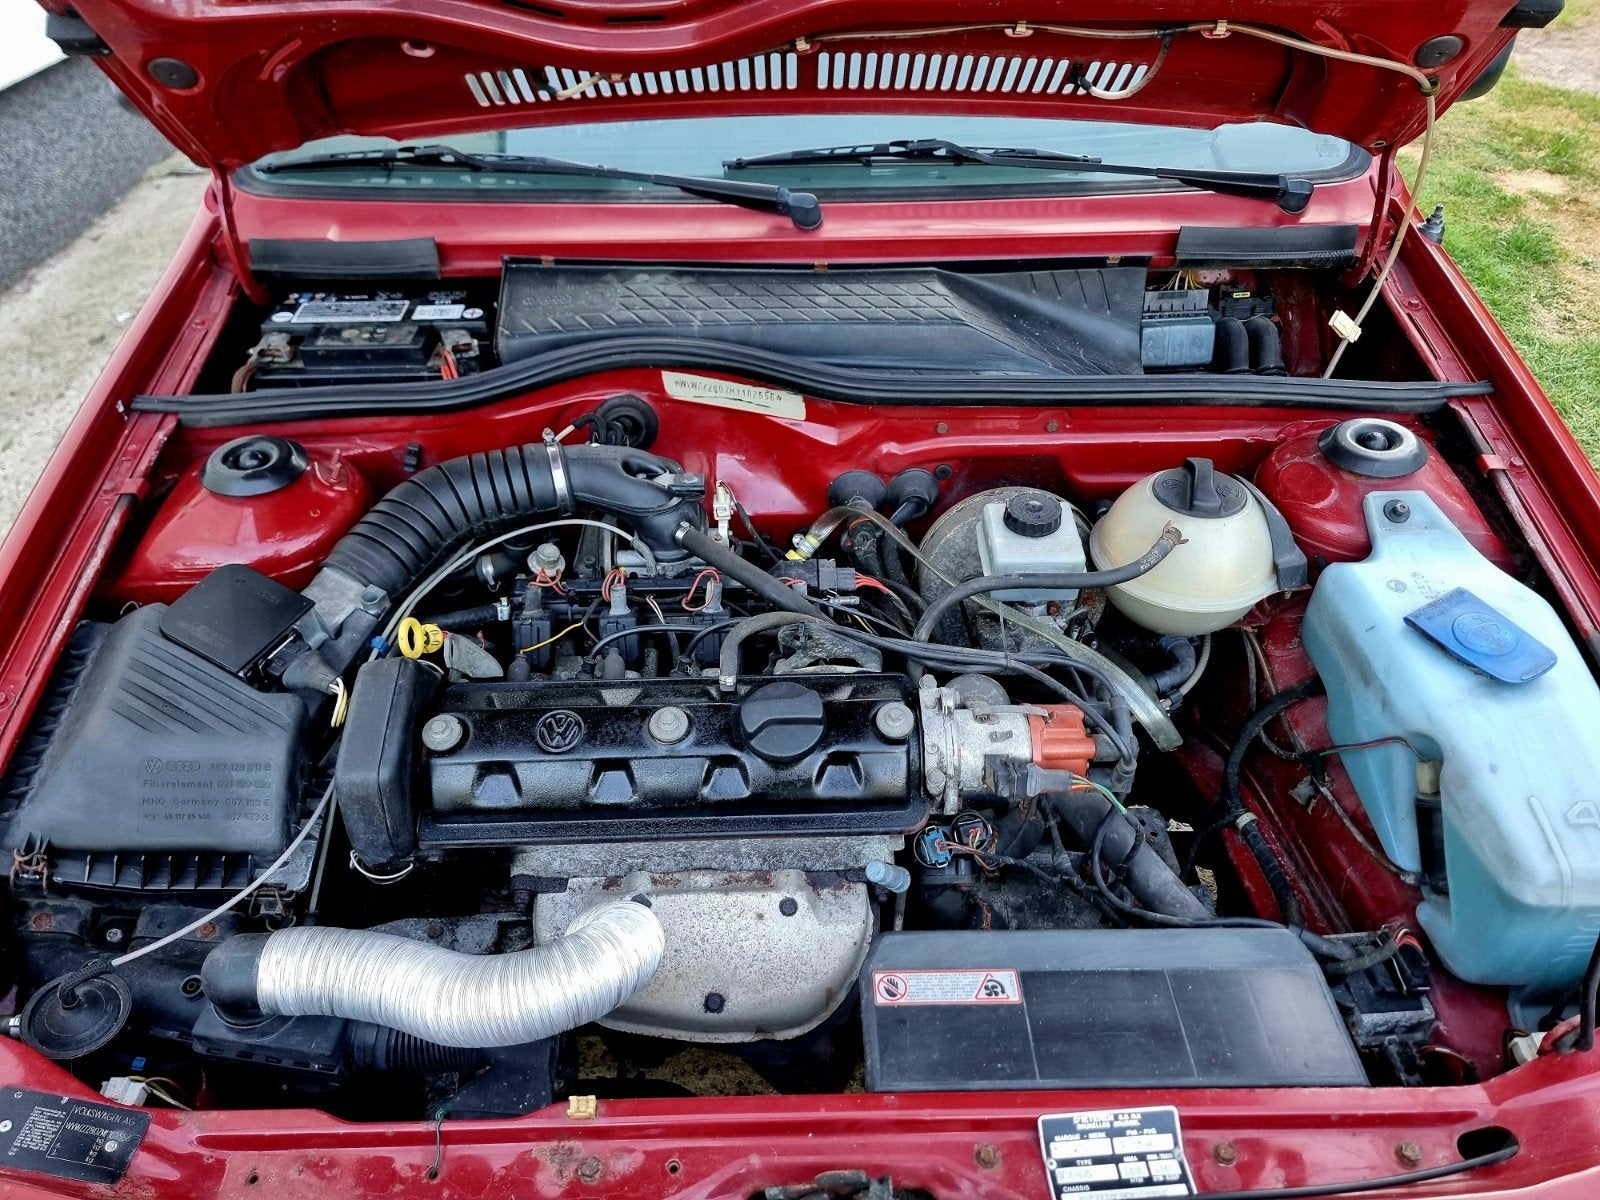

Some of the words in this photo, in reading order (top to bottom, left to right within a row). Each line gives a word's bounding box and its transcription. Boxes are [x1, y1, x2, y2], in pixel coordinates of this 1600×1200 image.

[74, 1106, 122, 1122] VOLKSWAGEN
[123, 1116, 136, 1126] AG
[1062, 1184, 1090, 1193] CHASSIS
